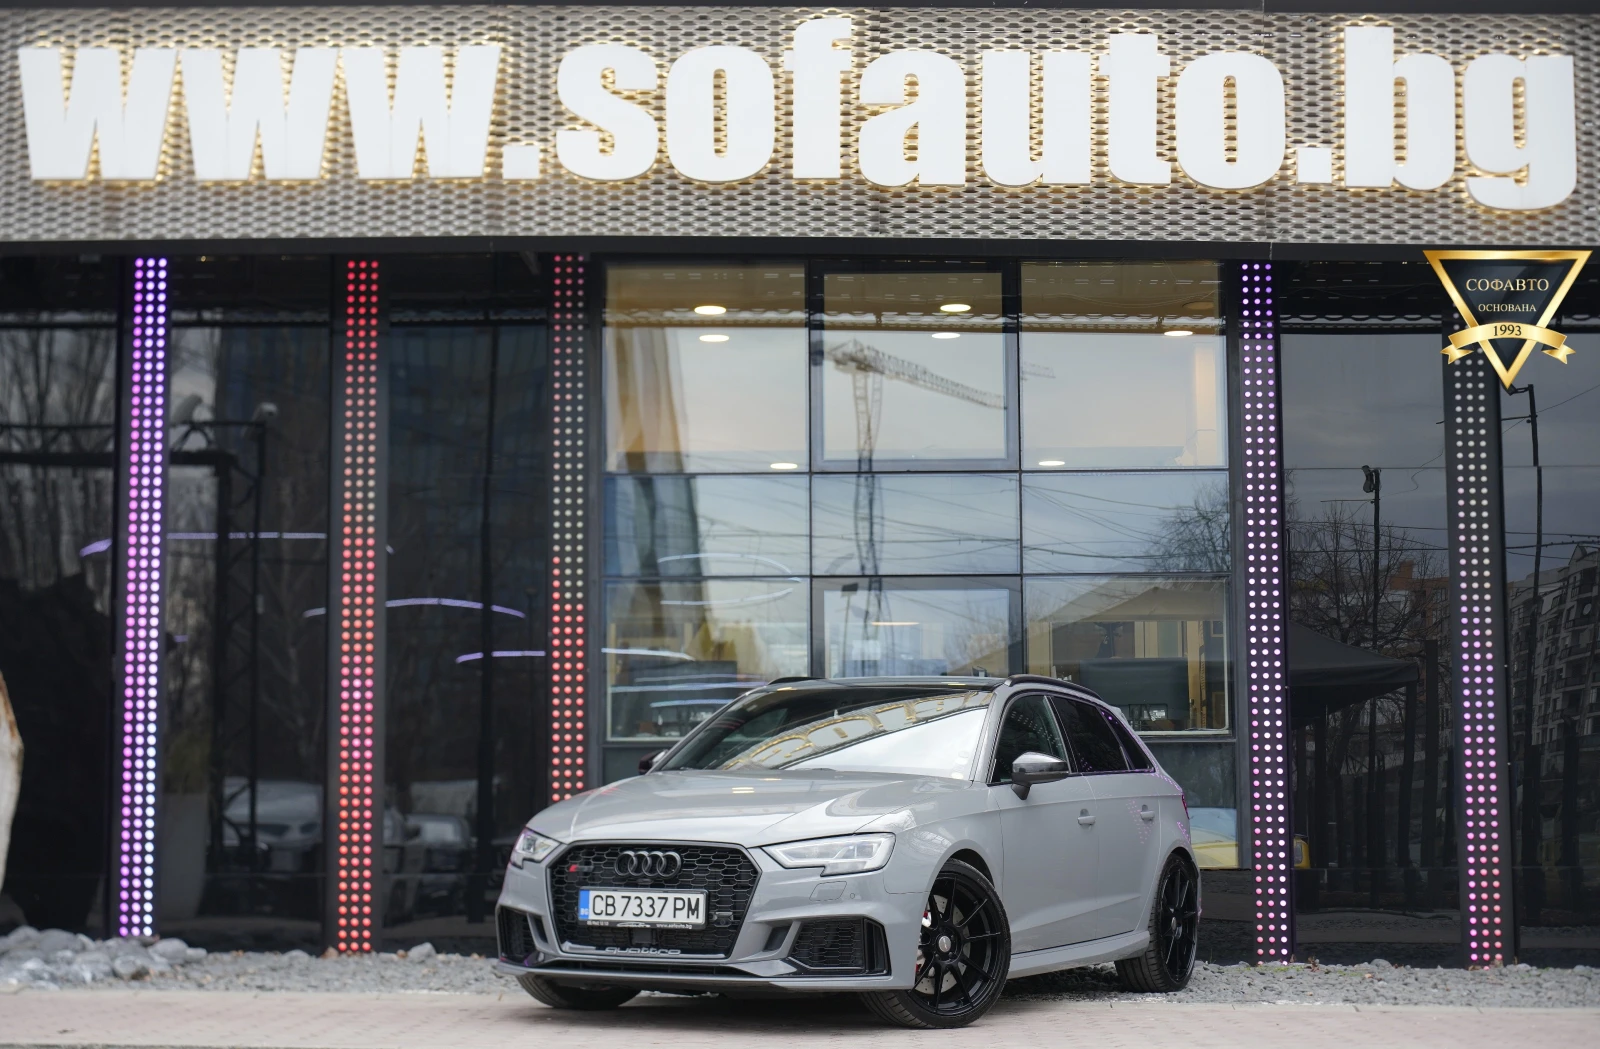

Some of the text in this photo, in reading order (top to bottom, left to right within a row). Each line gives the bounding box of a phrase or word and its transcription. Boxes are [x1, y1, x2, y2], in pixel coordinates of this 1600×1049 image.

[18, 16, 1577, 210] www.sofauto.bg
[592, 895, 616, 916] CB
[621, 896, 668, 918] 7337
[673, 897, 700, 919] PM
[605, 947, 681, 955] quattro
